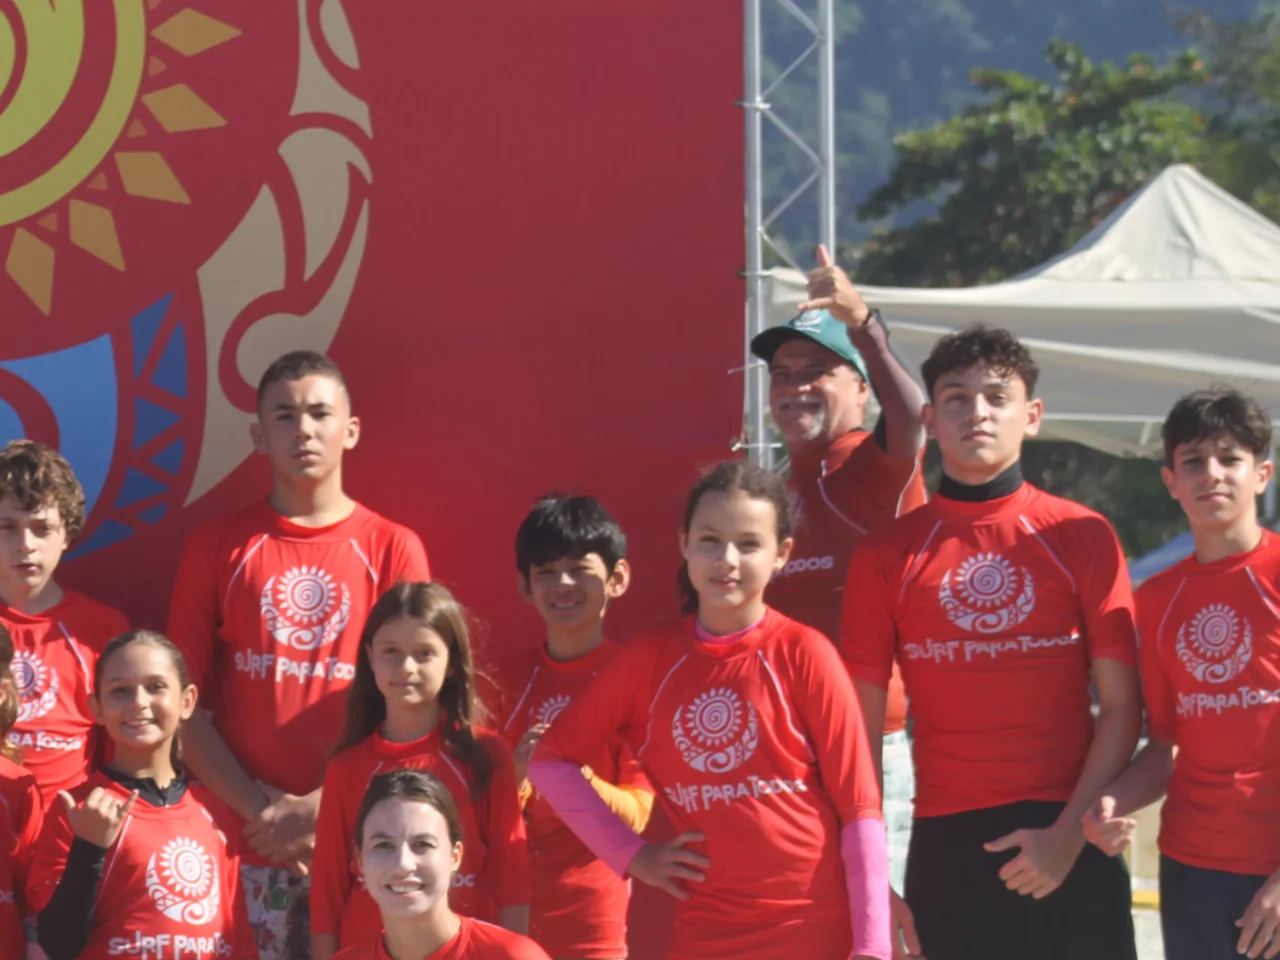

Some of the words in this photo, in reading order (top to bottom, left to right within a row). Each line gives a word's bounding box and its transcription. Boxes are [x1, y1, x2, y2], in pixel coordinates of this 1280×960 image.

[904, 638, 959, 663] SURF
[963, 640, 1018, 661] PARA
[235, 647, 275, 679] SURF
[275, 656, 325, 684] PARA
[325, 657, 356, 681] TOD
[1197, 693, 1239, 717] PARA
[701, 782, 750, 811] PARA
[107, 930, 171, 960] SURF
[173, 935, 215, 960] PARA
